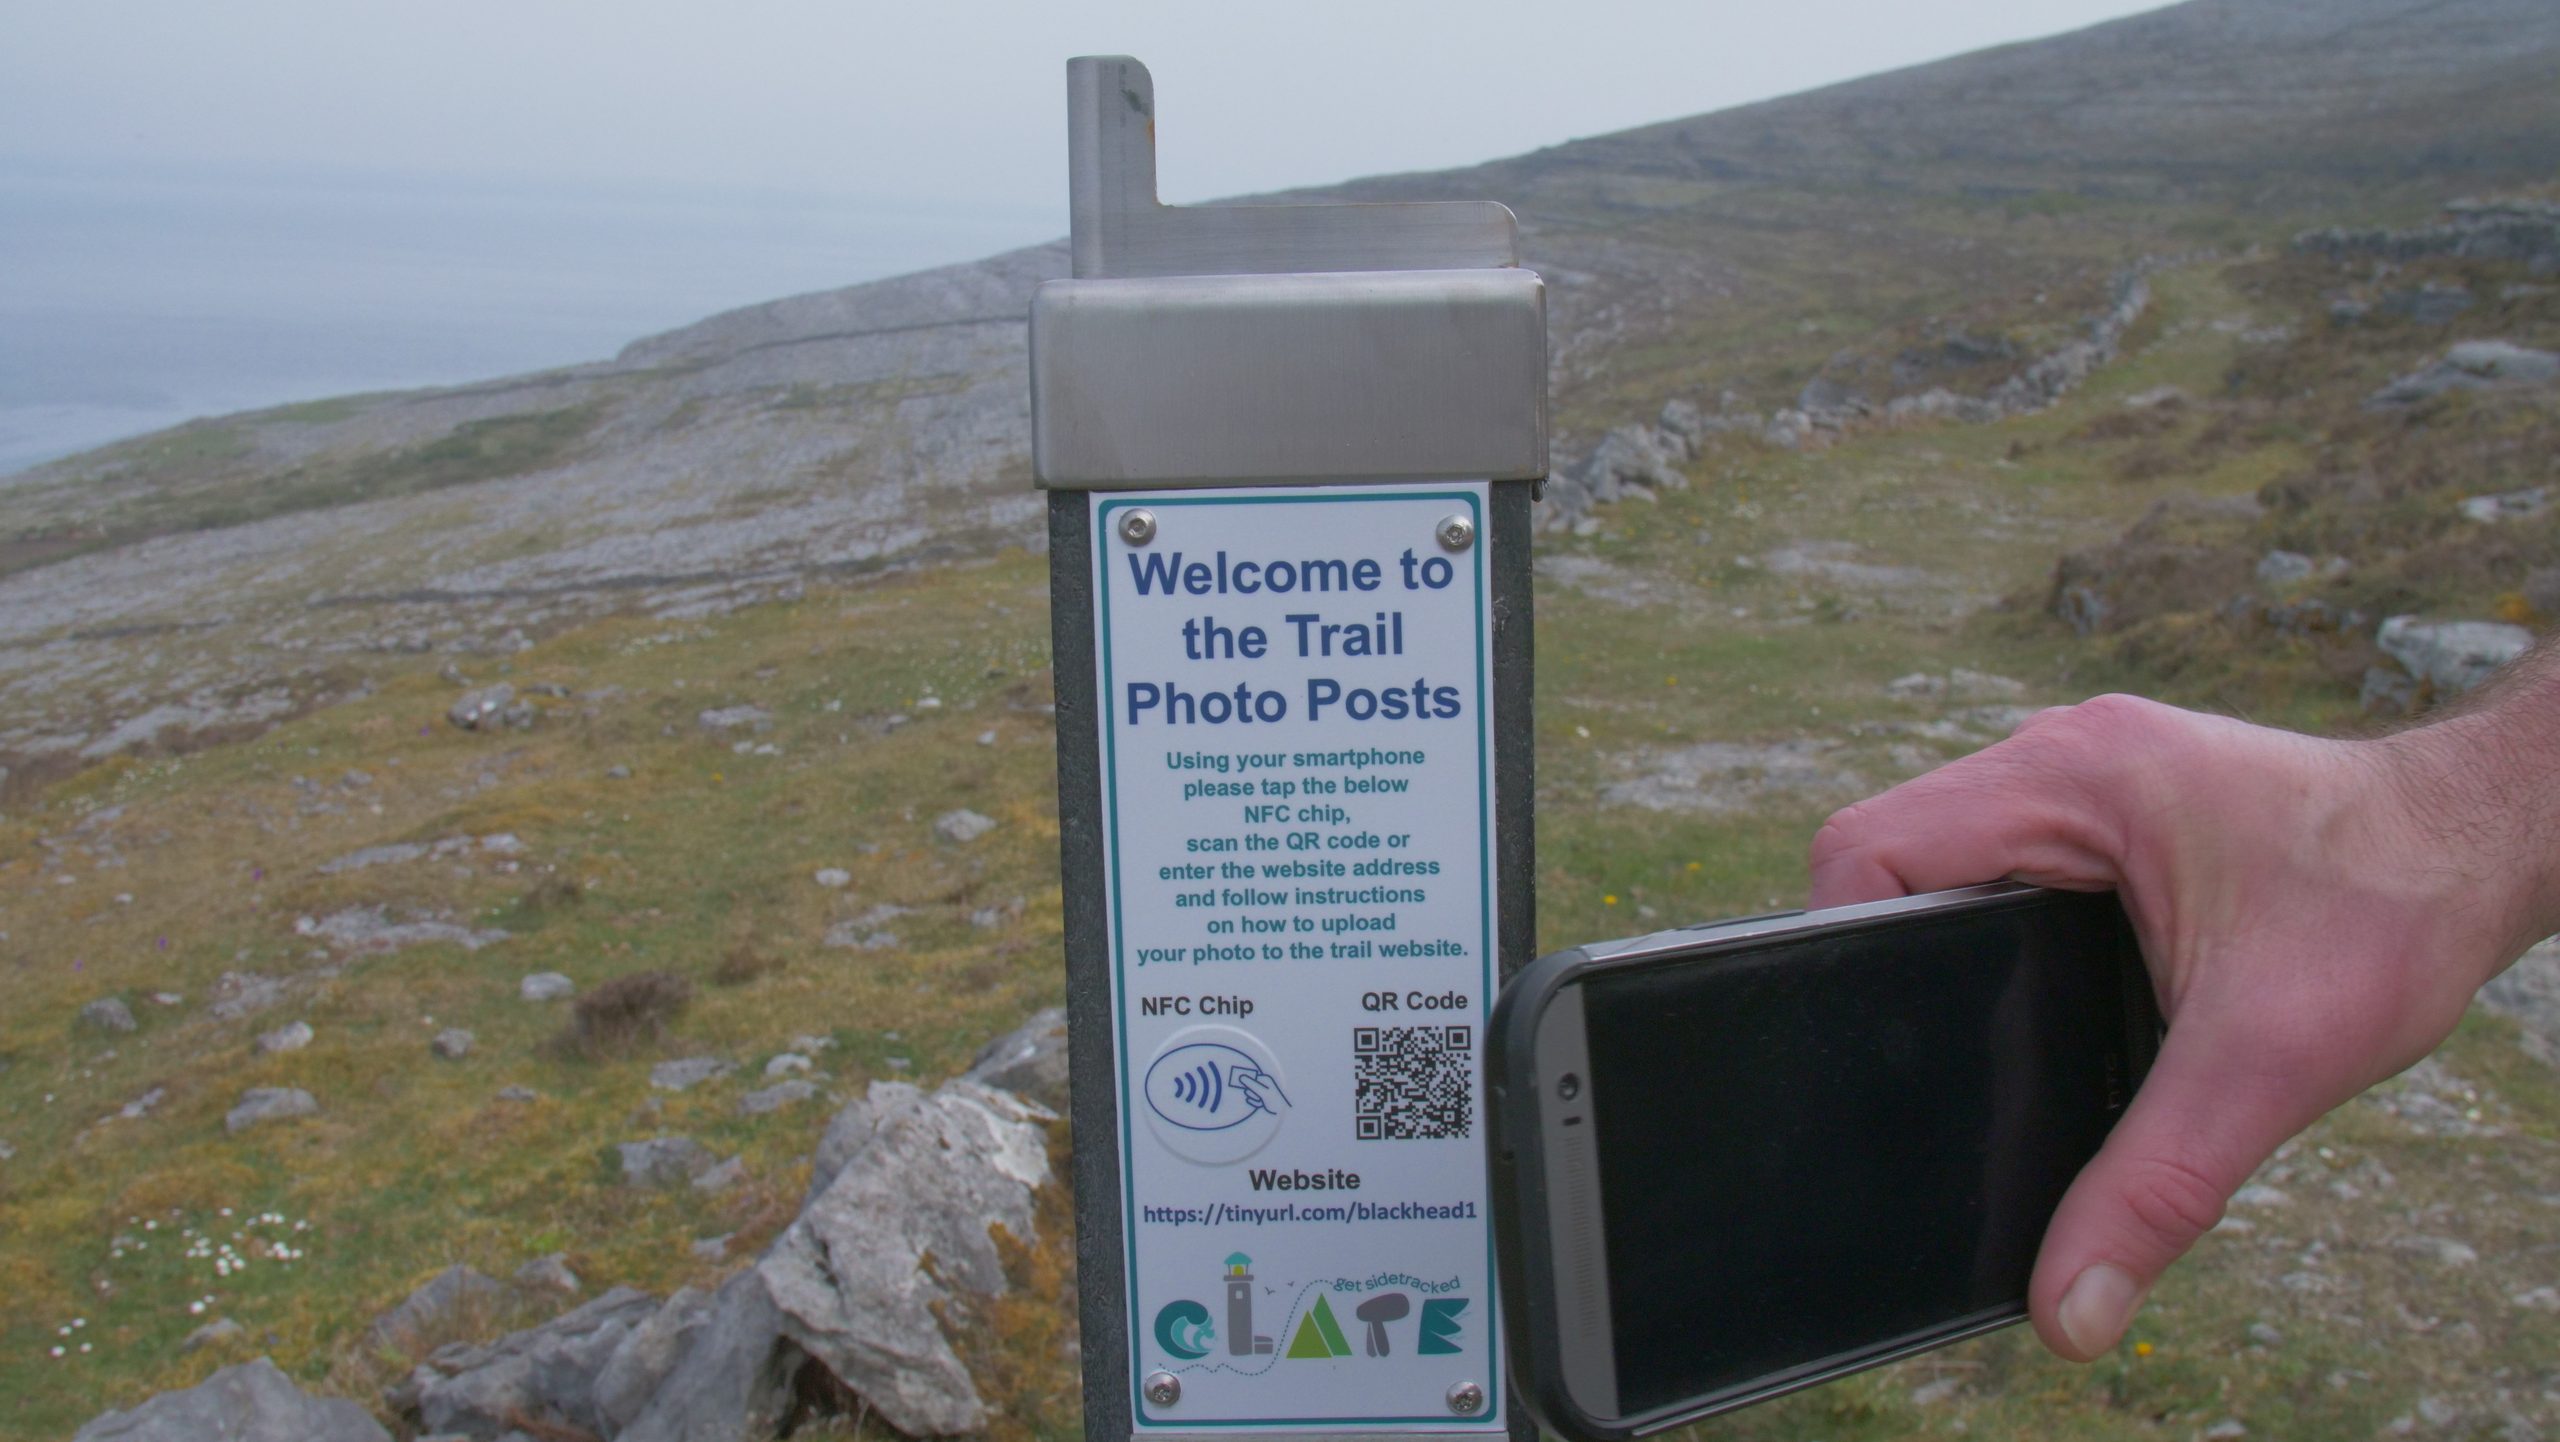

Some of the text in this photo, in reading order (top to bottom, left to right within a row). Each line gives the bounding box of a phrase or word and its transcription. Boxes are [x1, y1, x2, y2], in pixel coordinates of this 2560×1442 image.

[1128, 548, 1454, 595] Welcome to
[1182, 612, 1402, 660] the Trail
[1128, 678, 1461, 725] Photo Posts
[1167, 748, 1424, 773] Using your smartphone
[1184, 776, 1408, 801] please tap the below
[1245, 804, 1350, 825] NFC chip,
[1187, 831, 1410, 852] scan the QR code or
[1159, 858, 1440, 880] enter the website address
[1176, 886, 1425, 907] and follow instructions
[1207, 913, 1395, 935] on how to upload
[1137, 940, 1467, 967] your photo to the trail website.
[1142, 996, 1253, 1019] NFC Chip
[1362, 991, 1467, 1012] QR Code
[1249, 1169, 1360, 1191] Website
[1144, 1201, 1477, 1226] https://tinyurl.com/blackhead1
[1333, 1272, 1460, 1294] get sidetracked
